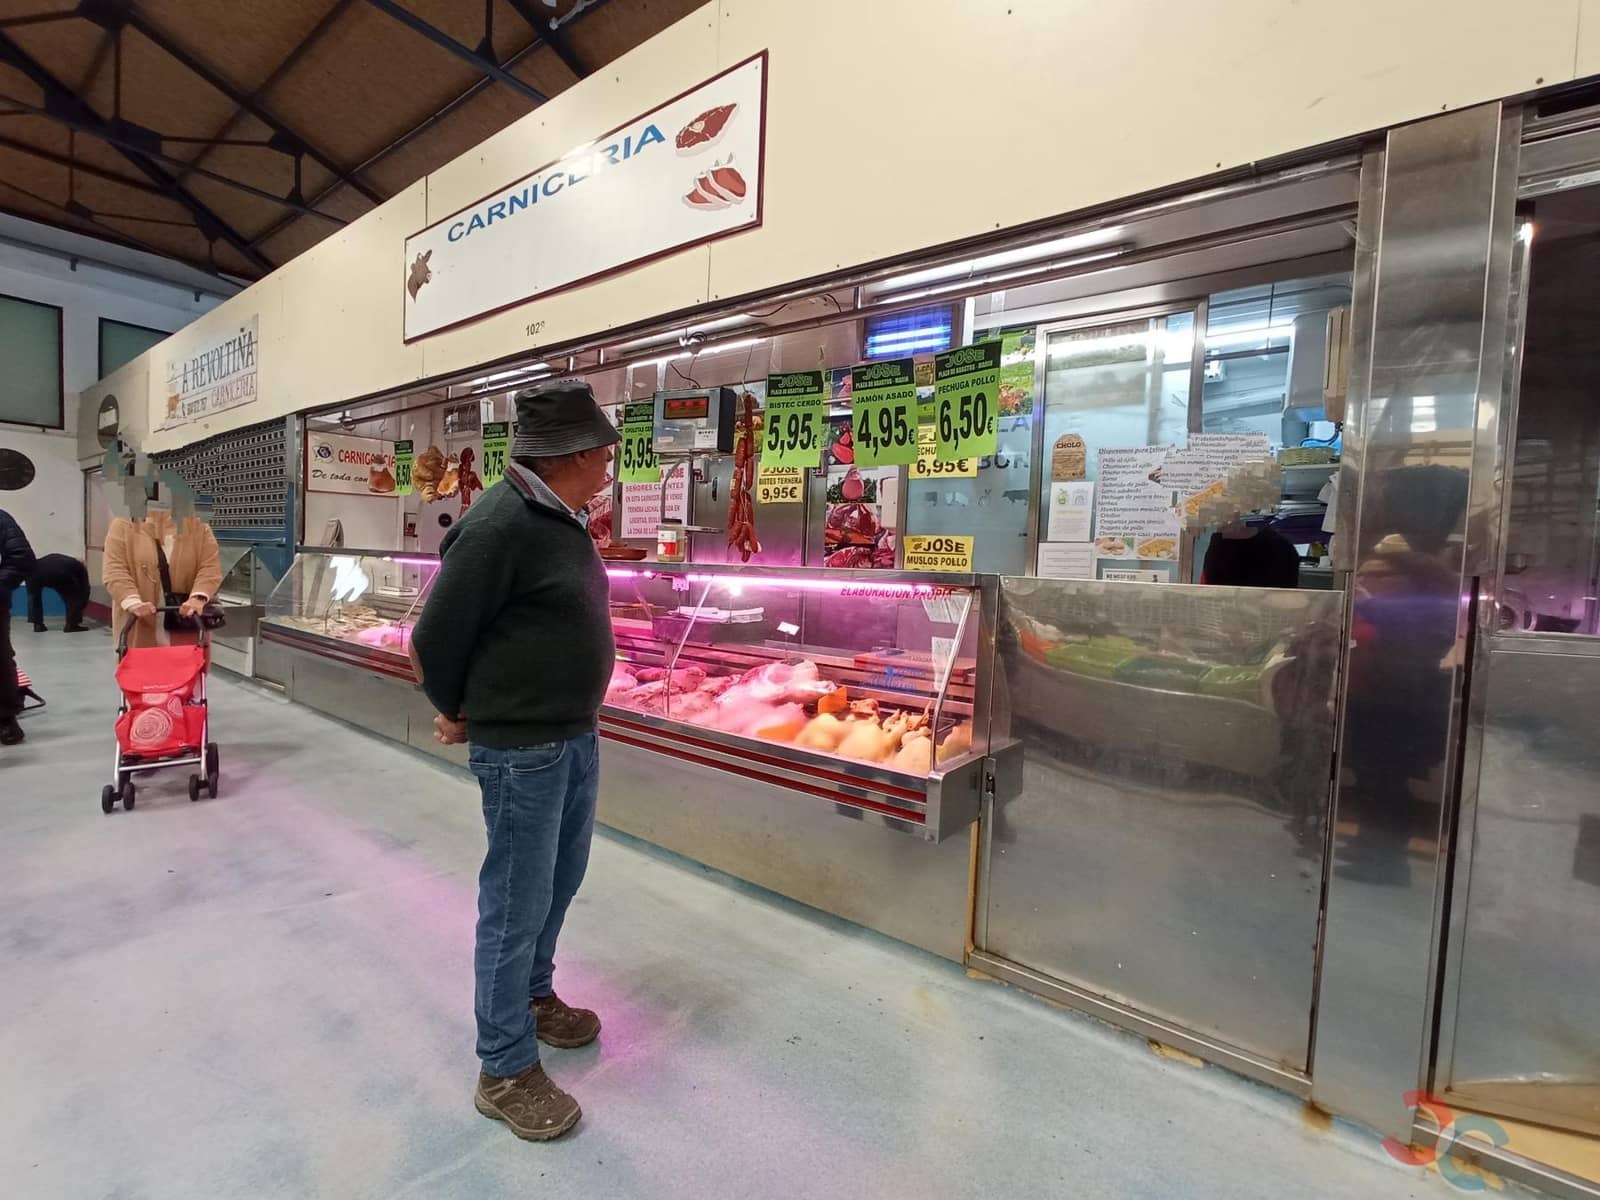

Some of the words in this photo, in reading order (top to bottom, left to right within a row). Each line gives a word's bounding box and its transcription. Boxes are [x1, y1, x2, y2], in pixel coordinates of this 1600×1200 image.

[182, 362, 189, 394] A
[192, 327, 255, 390] REVOLTIÑA
[944, 347, 985, 368] JOSE
[862, 363, 902, 381] JOSE
[778, 375, 813, 388] JOSE
[971, 375, 996, 388] POLLO
[885, 390, 914, 401] ASADO
[769, 401, 796, 409] BISTEC
[796, 399, 821, 408] CERDO
[918, 446, 936, 456] ECHU
[312, 469, 327, 480] De
[329, 470, 351, 482] toda
[653, 481, 684, 491] CLNTES
[762, 486, 798, 501] 9,95€
[923, 538, 965, 553] JOSE
[907, 555, 938, 566] MUSLOS
[940, 557, 968, 567] POLLO
